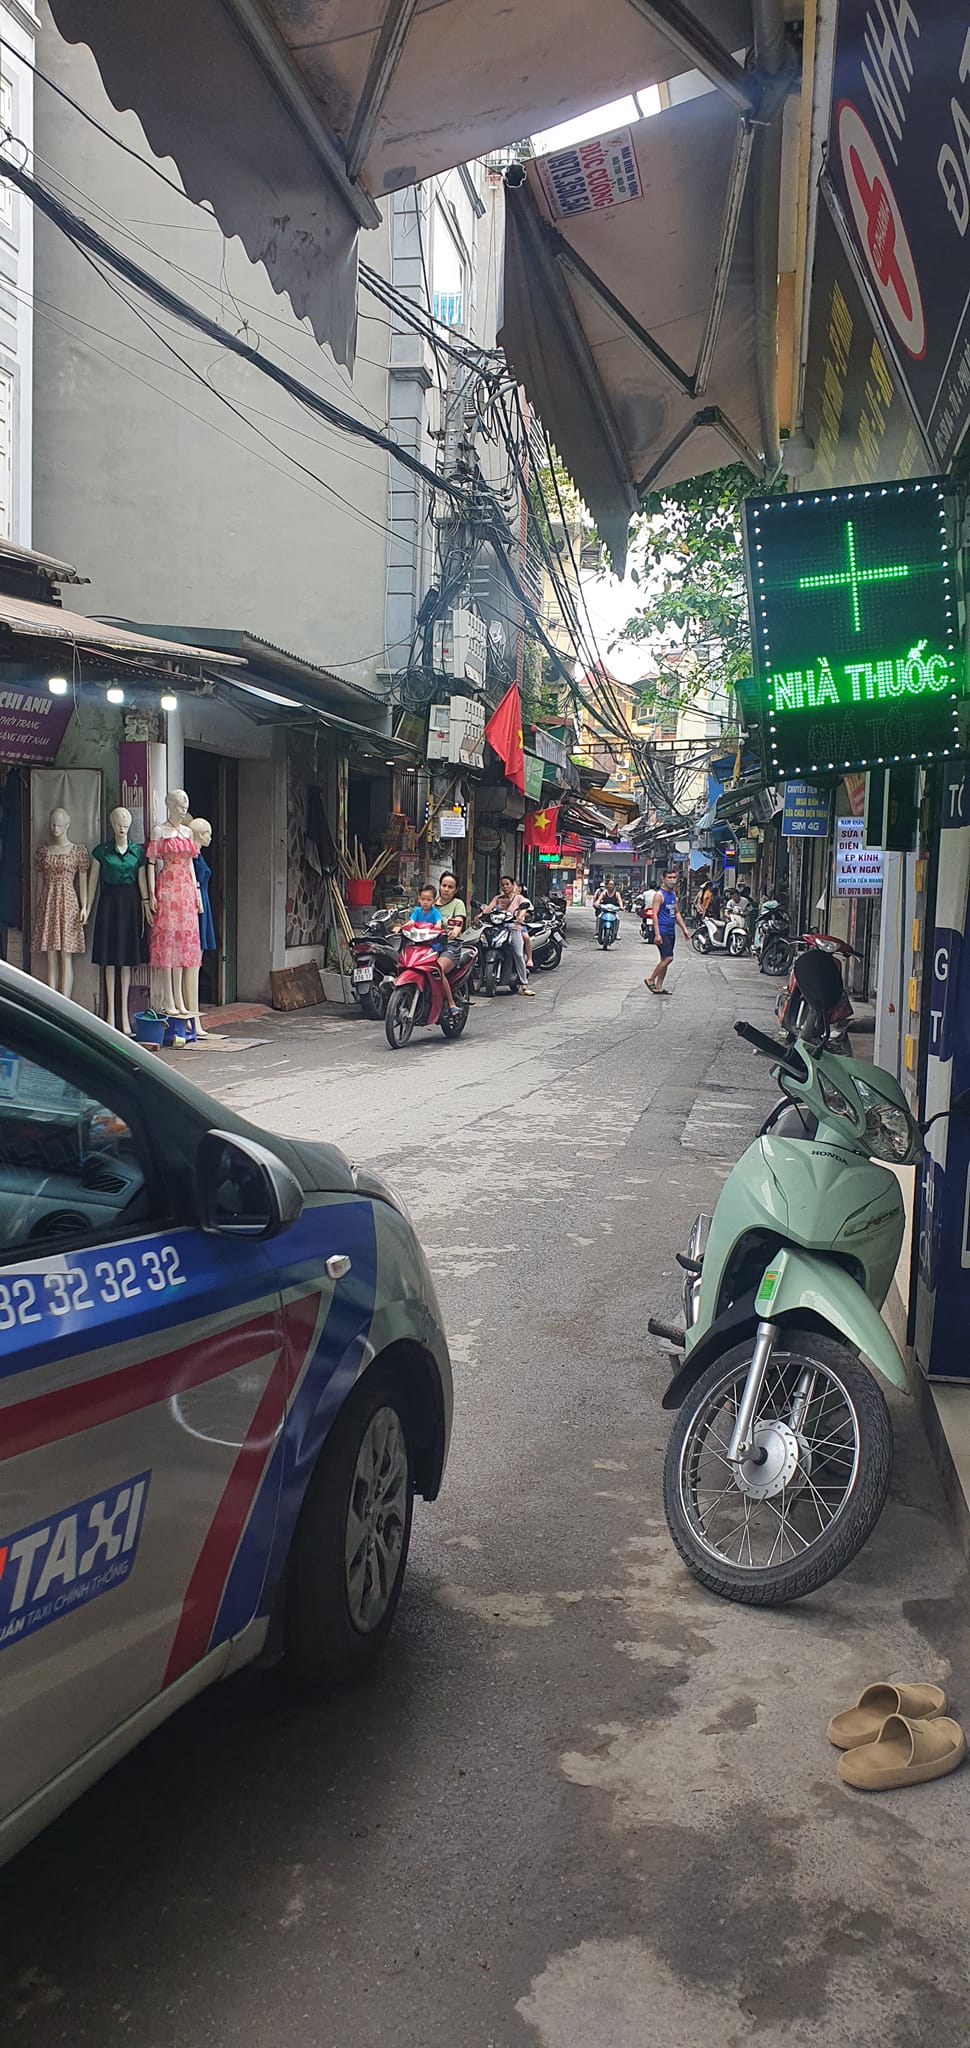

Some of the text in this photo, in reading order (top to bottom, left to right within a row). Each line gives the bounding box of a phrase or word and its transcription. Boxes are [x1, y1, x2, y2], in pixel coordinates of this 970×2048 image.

[547, 151, 593, 216] 0979.350.541
[579, 142, 617, 207] ĐỨC CƯỜNG
[773, 639, 949, 711] NHÀ THUỐC
[22, 695, 53, 715] ANH
[16, 719, 41, 730] TRANG
[807, 696, 924, 760] GIÁ TỐT
[16, 732, 32, 745] VIỆT
[32, 736, 50, 746] NAM
[791, 821, 820, 831] SIM 4G
[841, 827, 858, 838] SỬA
[845, 852, 879, 862] ÉP KÍNH
[842, 864, 881, 874] LẤY NGAY
[812, 1150, 849, 1165] HONDA
[43, 1267, 95, 1316] 32
[95, 1257, 142, 1303] 32
[141, 1245, 187, 1291] 32
[9, 1480, 146, 1614] TAXI
[28, 1605, 53, 1625] TAXI
[53, 1583, 90, 1612] CHÍNH
[92, 1560, 129, 1591] THỐNG
